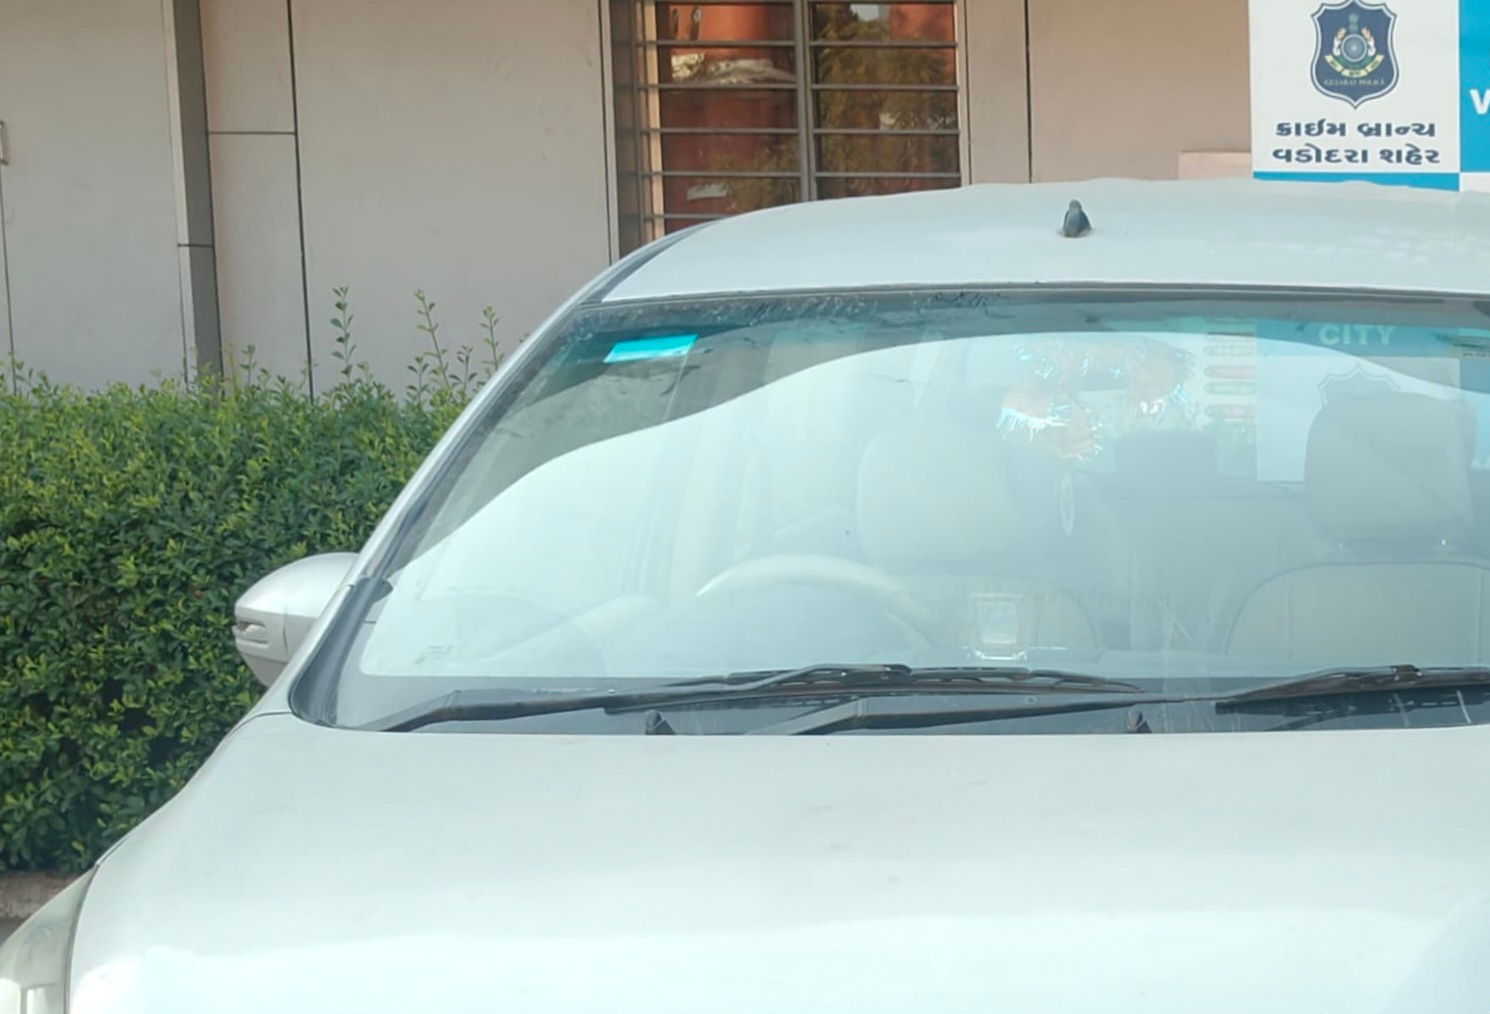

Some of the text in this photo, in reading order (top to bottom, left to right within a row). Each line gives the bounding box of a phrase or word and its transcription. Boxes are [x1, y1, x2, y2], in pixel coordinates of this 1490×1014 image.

[1357, 123, 1435, 137] બ્રાન્ચ
[1272, 143, 1440, 165] વડોદરા શહેર
[1319, 323, 1396, 346] CITY
